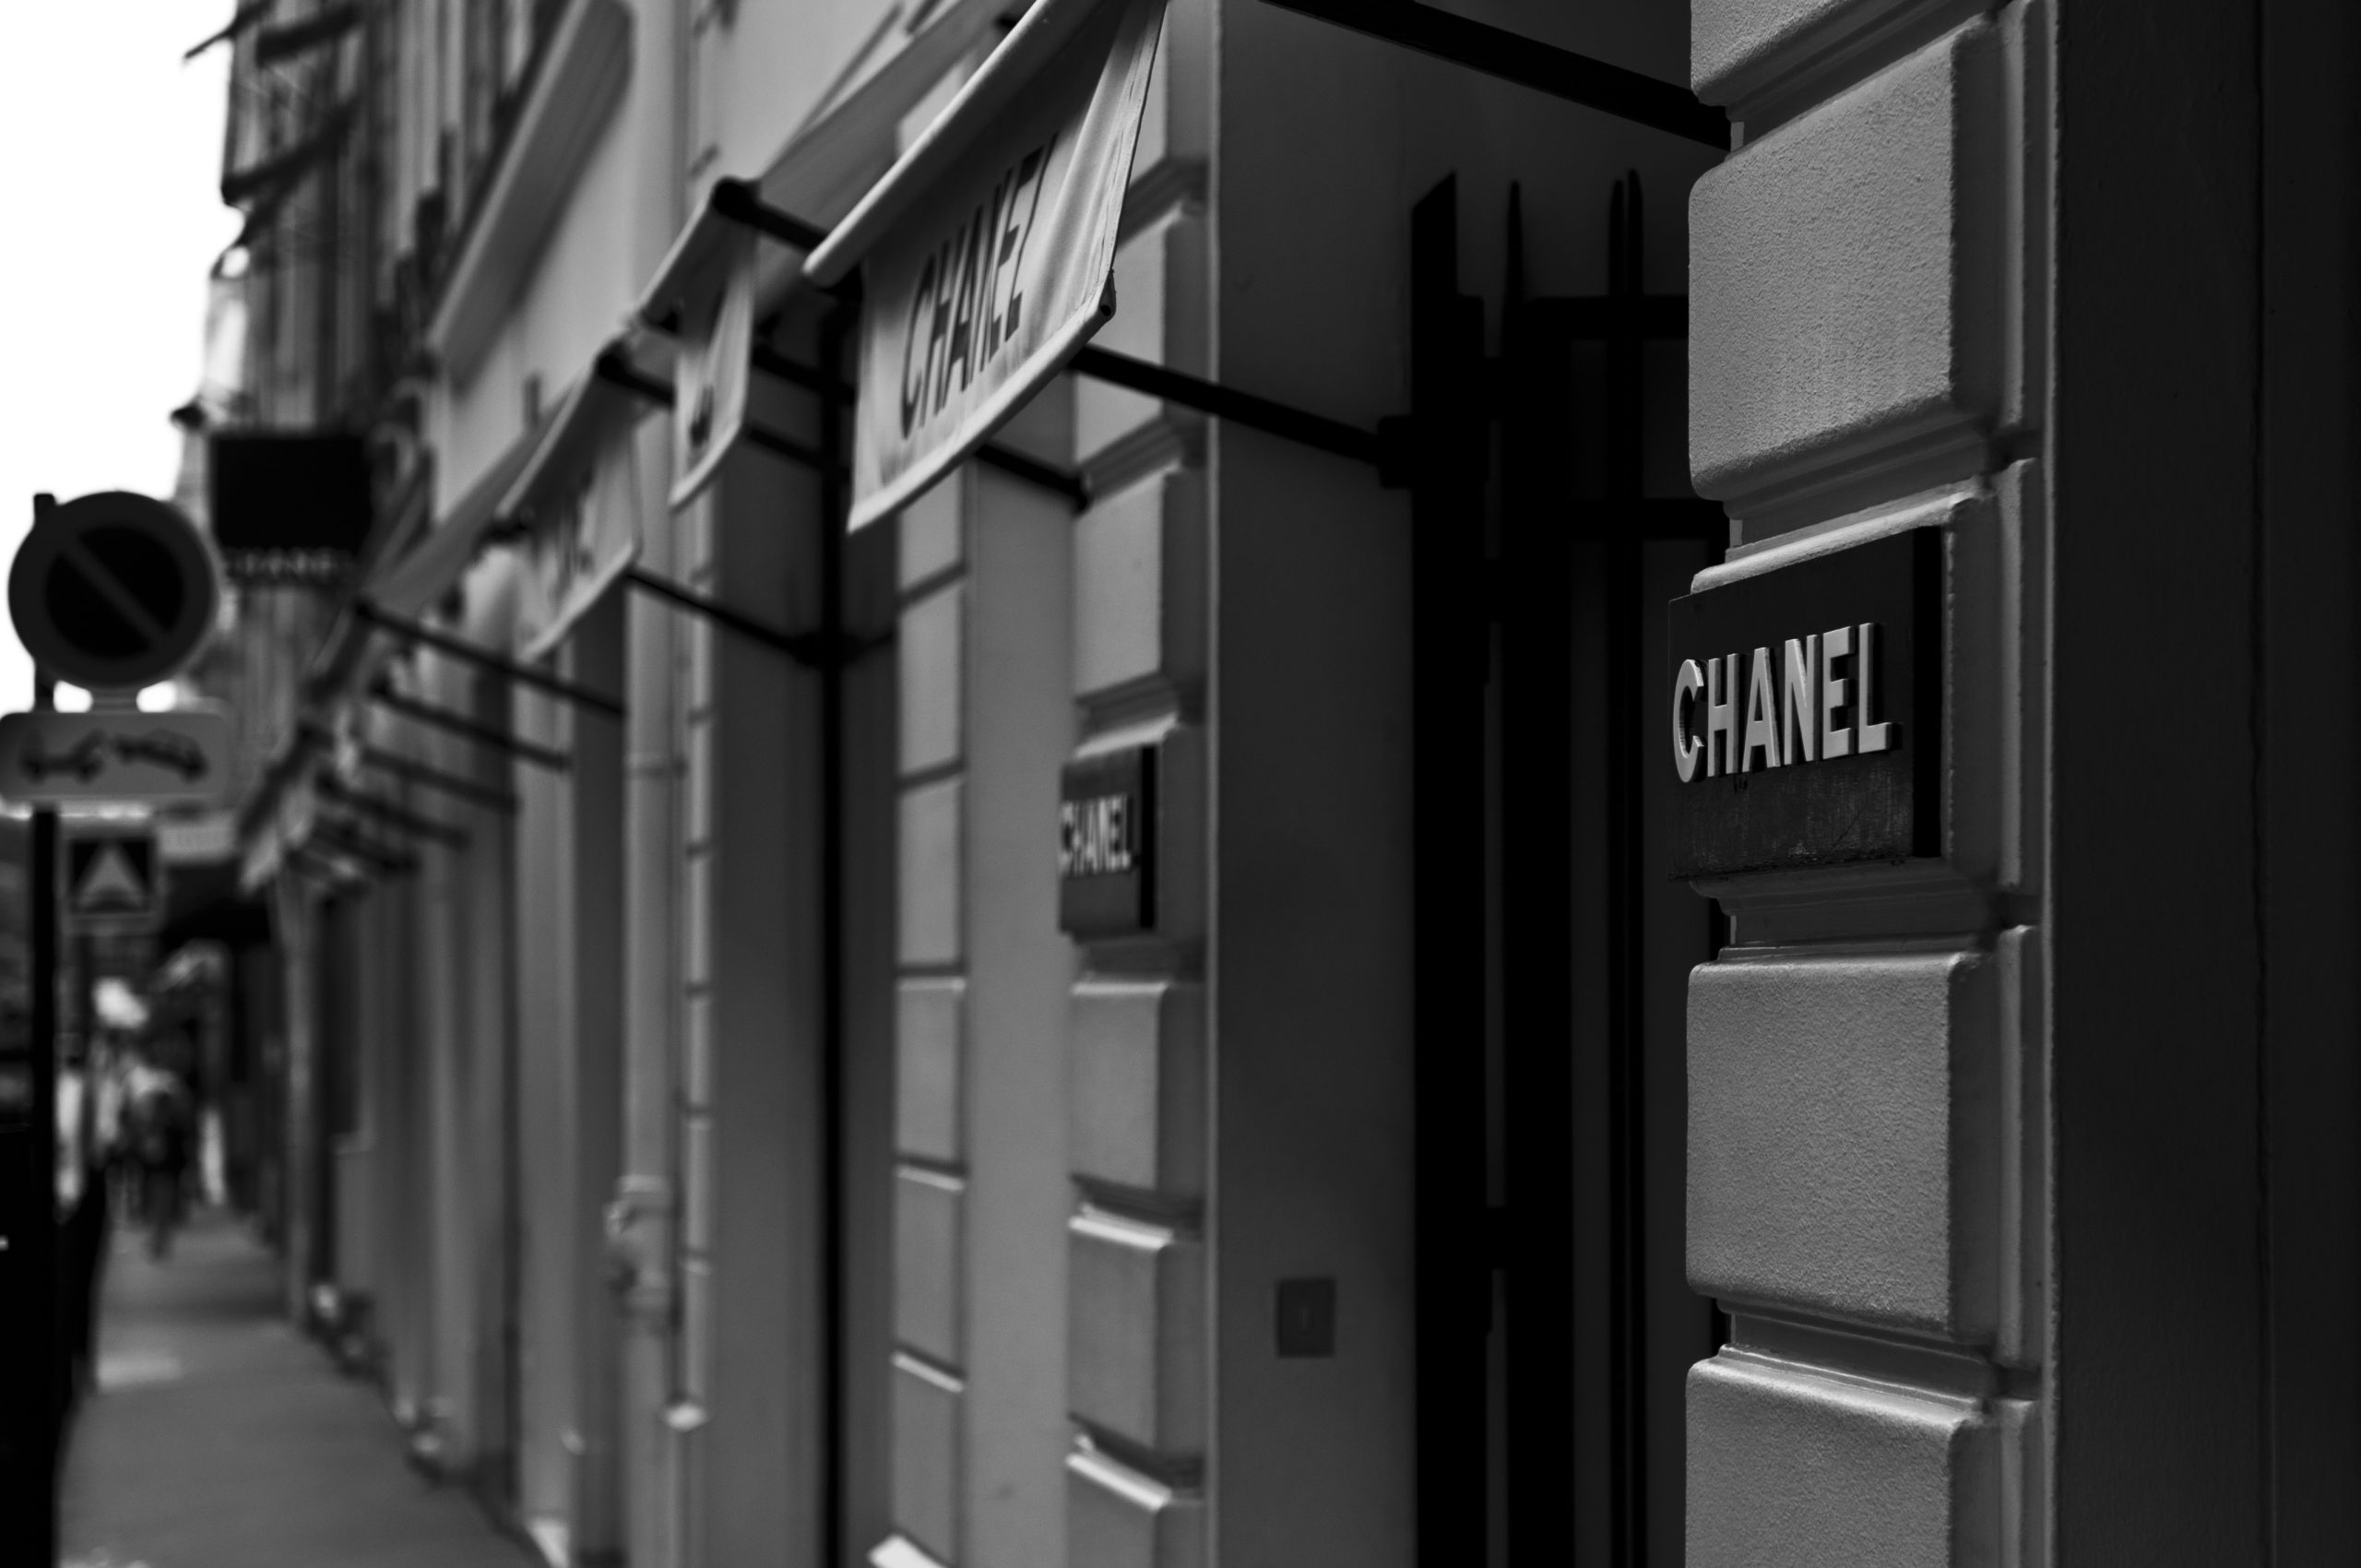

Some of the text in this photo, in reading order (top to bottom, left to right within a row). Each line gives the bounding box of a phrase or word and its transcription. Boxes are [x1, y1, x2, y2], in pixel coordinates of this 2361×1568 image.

[901, 132, 1058, 440] CHANEL
[1672, 622, 1894, 783] CHANEL
[1061, 794, 1132, 874] CHANEL
